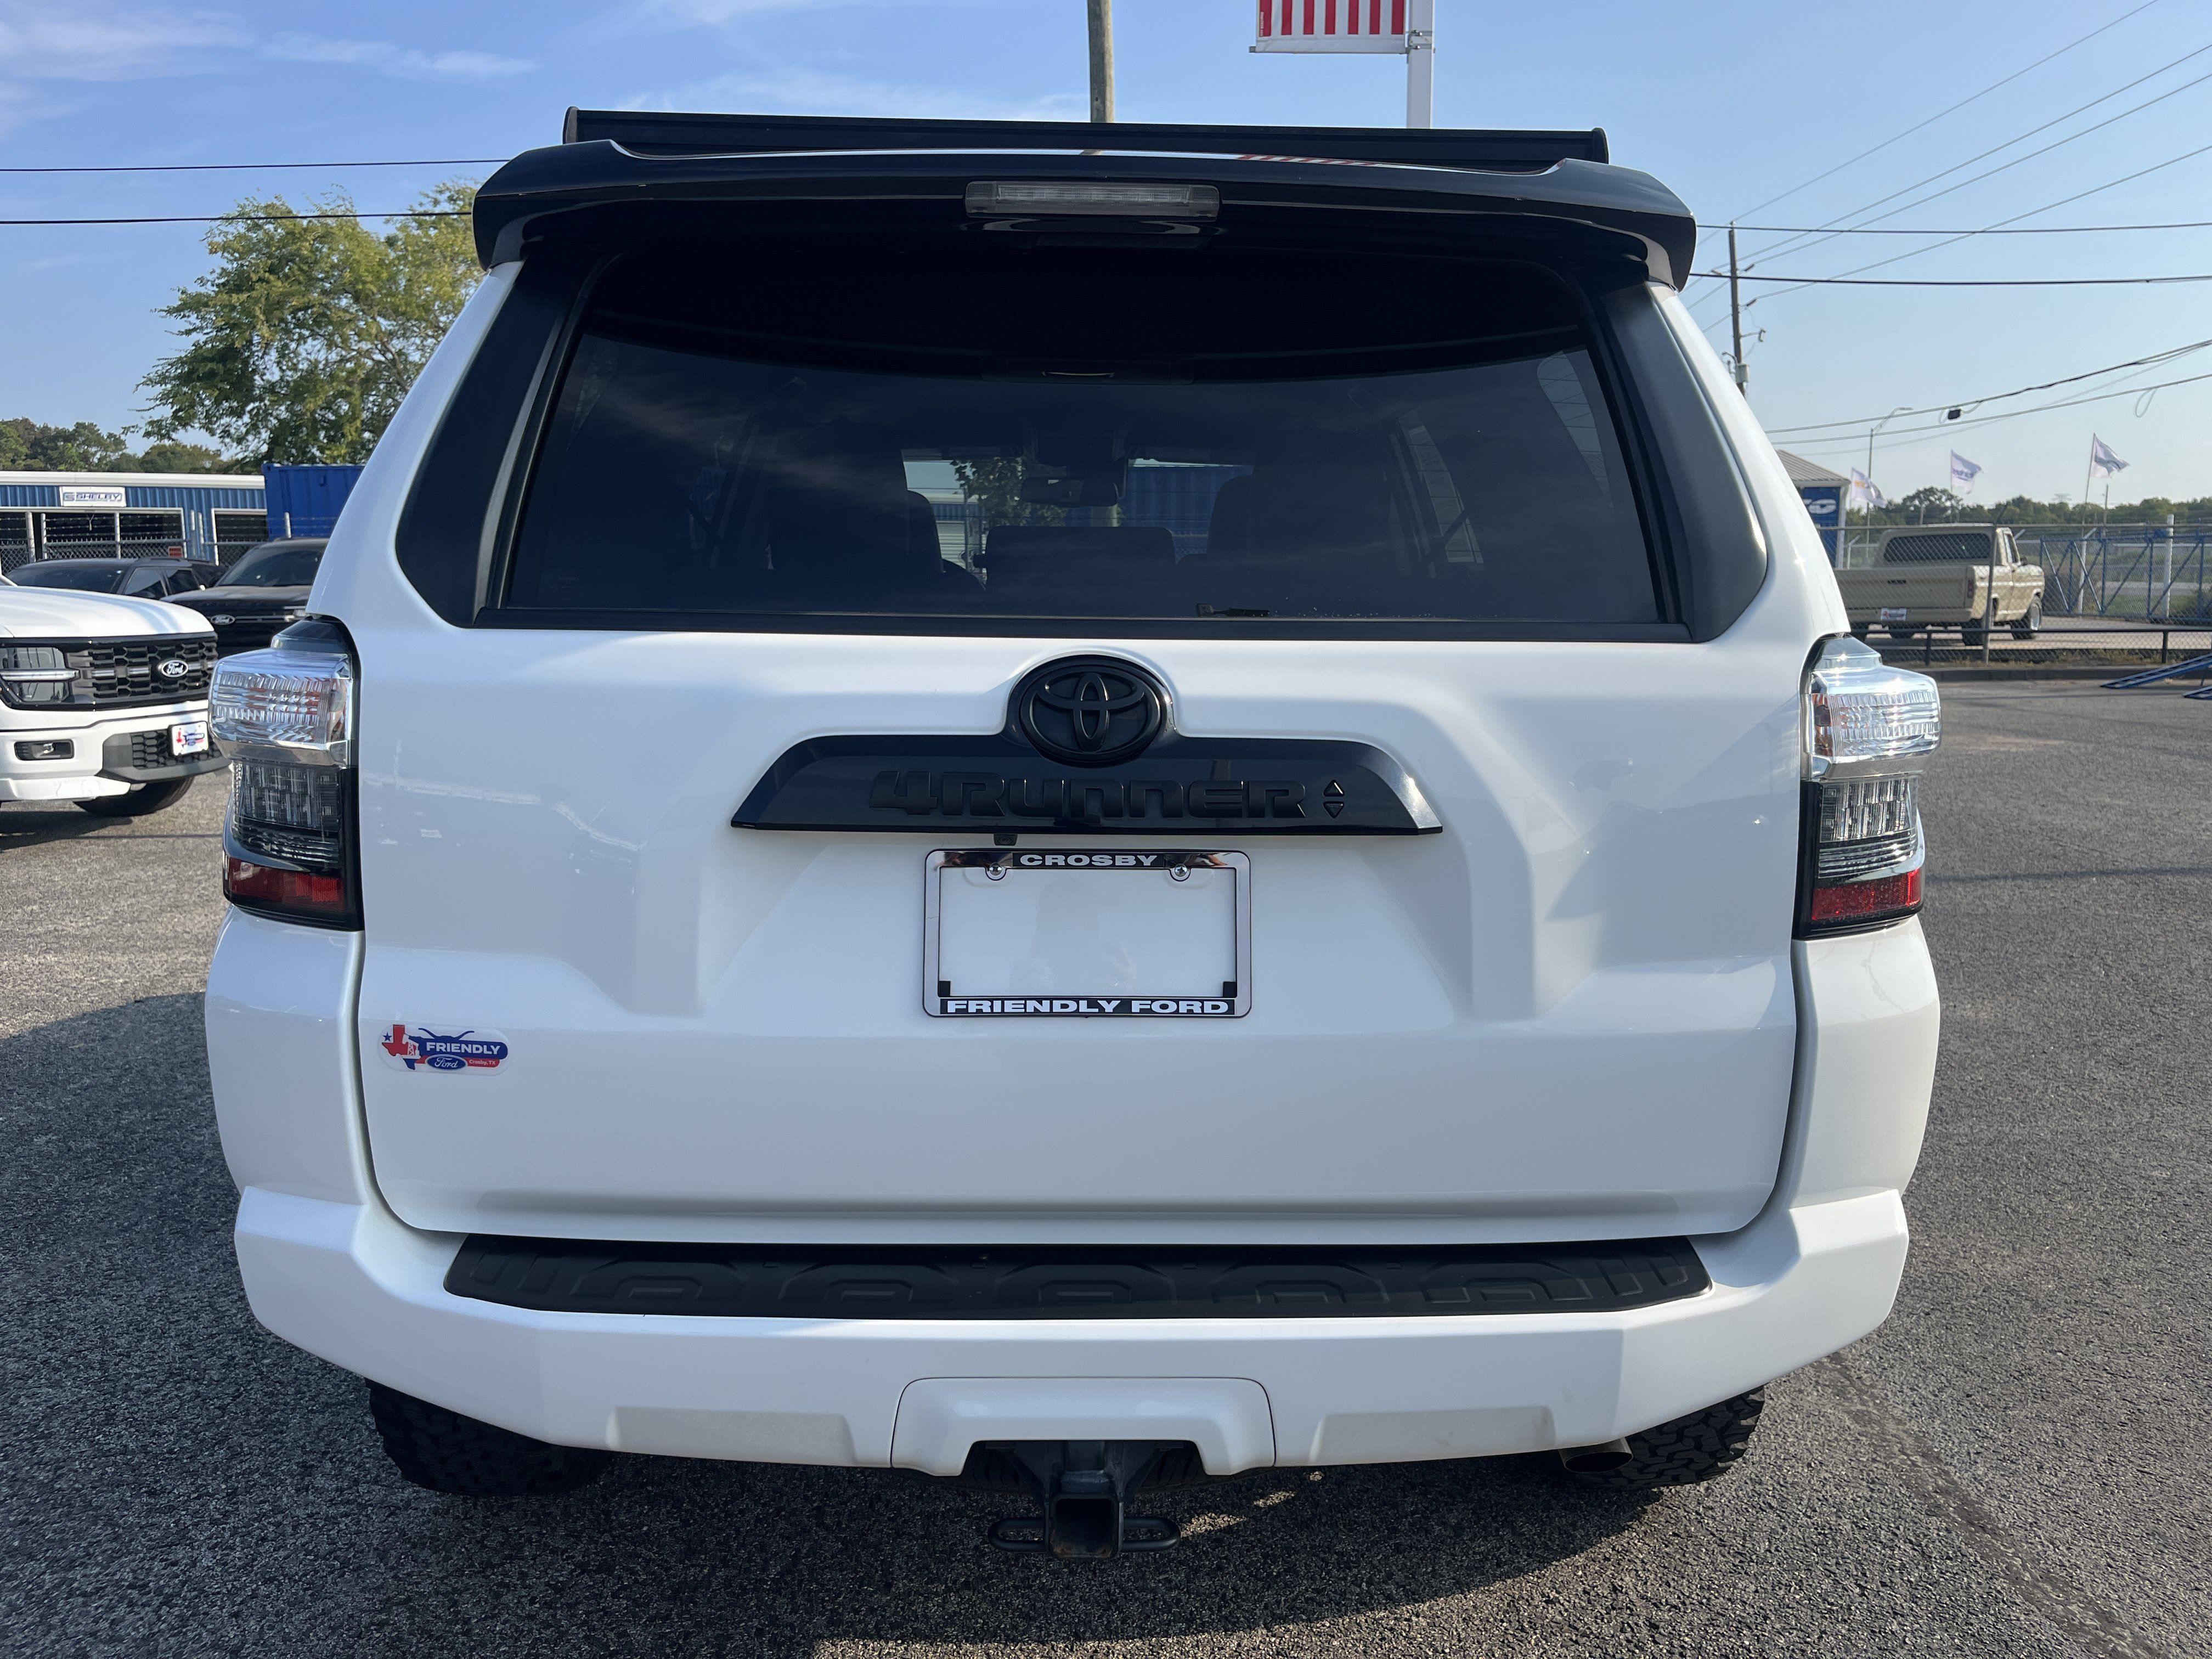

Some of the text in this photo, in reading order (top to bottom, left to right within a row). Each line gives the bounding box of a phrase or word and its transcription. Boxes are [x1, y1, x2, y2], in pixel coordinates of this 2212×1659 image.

[1020, 854, 1157, 866] CROSBY
[947, 1000, 1228, 1014] FRIENDLY FORD
[426, 1042, 500, 1054] FRIENDLY
[435, 1057, 458, 1068] Ford
